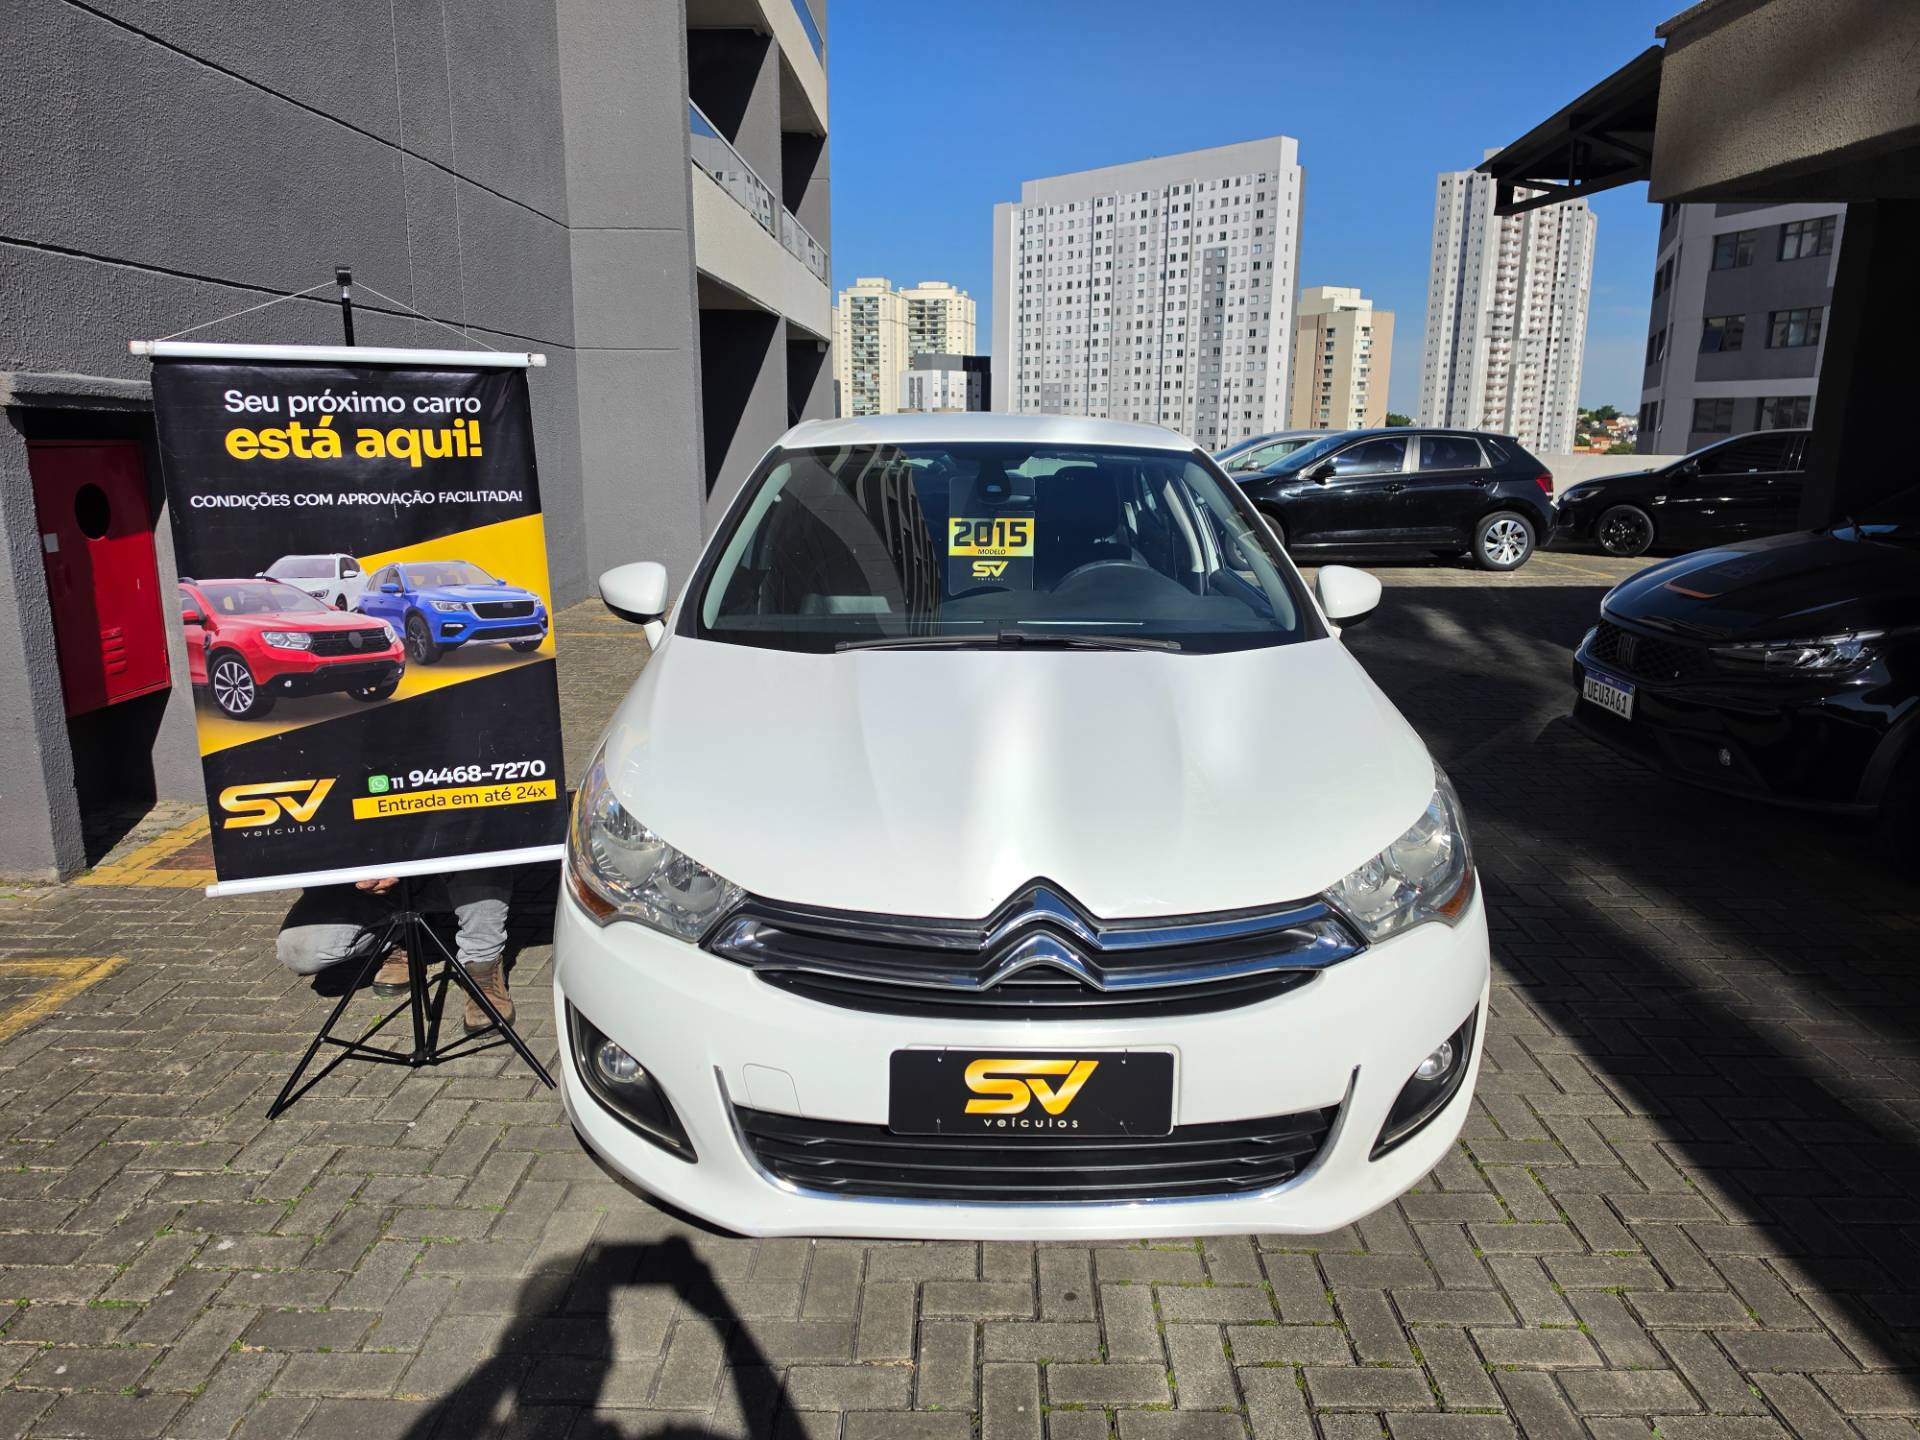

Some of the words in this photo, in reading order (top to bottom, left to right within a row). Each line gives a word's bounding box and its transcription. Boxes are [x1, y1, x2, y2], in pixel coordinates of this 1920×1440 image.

[224, 389, 279, 413] Seu
[288, 388, 406, 418] próximo
[413, 392, 482, 414] carro
[224, 416, 342, 460] está
[355, 418, 483, 468] aqui!
[190, 492, 291, 511] CONDIÇÕES
[294, 493, 334, 507] COM
[337, 489, 436, 510] APROVAÇÃO
[439, 490, 523, 504] FACILITADA!
[953, 521, 1028, 548] 2015
[972, 560, 1009, 577] SV
[1587, 682, 1627, 715] UEU3A61
[390, 777, 404, 789] 11
[409, 759, 546, 788] 94468-7270
[218, 778, 337, 830] SV
[378, 794, 446, 813] Entrada
[451, 792, 479, 804] em
[484, 787, 512, 803] até
[516, 785, 548, 799] 24x
[964, 1058, 1100, 1116] SV
[983, 1117, 1079, 1128] veículos
